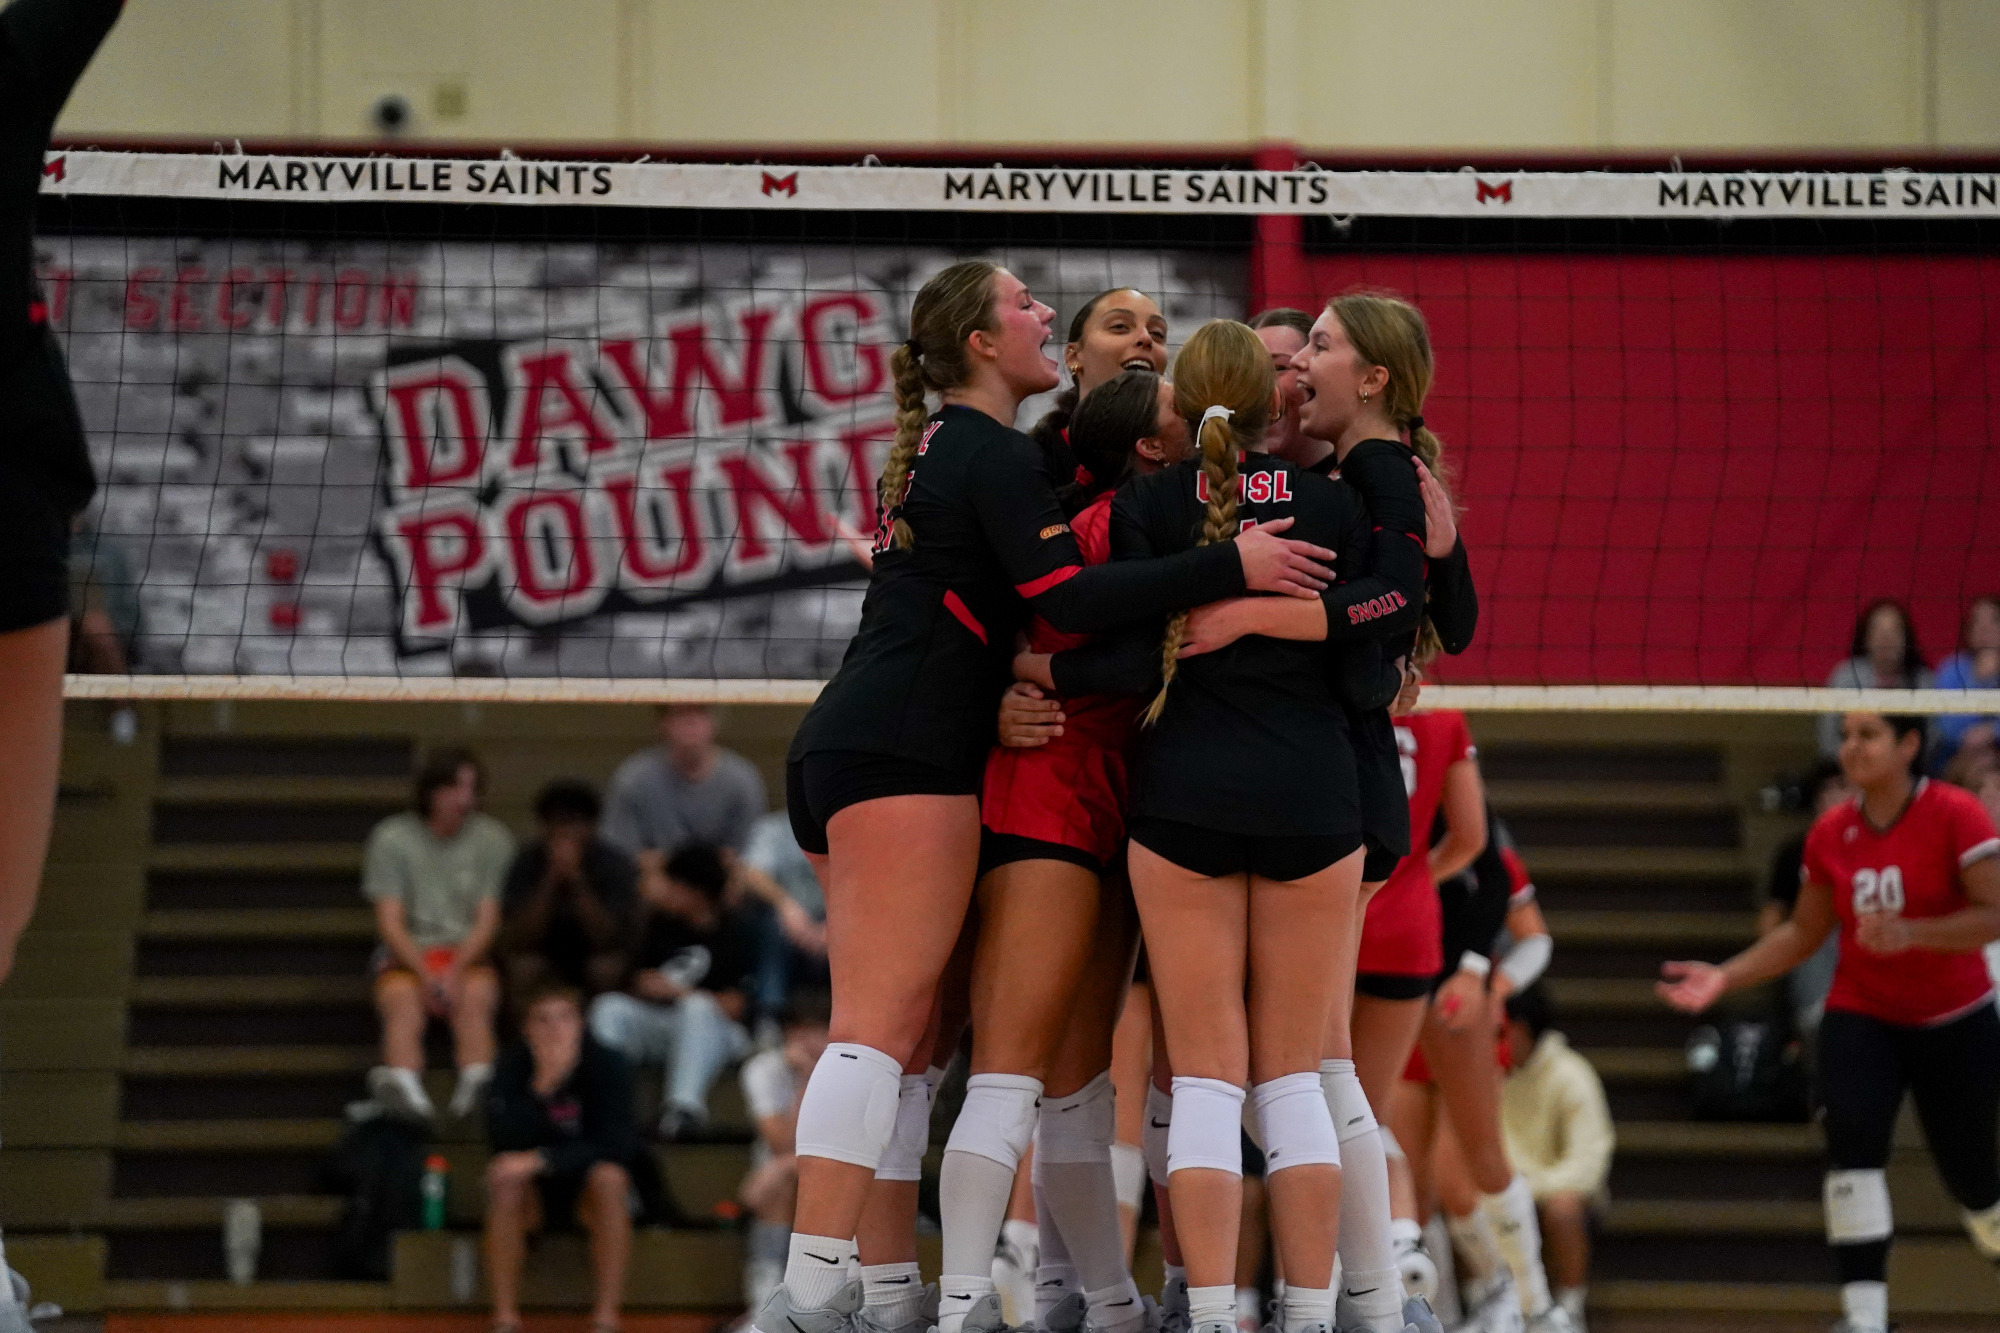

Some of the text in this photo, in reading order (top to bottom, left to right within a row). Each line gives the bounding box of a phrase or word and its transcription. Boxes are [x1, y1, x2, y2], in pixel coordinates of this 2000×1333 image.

[218, 160, 612, 195] MARYVILLE SAINTS
[944, 172, 1328, 204] MARYVILLE SAINTS
[1658, 178, 1998, 208] MARYVILLE SAIN
[125, 267, 417, 329] SECTION
[388, 292, 884, 488] DAWG
[1851, 865, 1906, 914] 20
